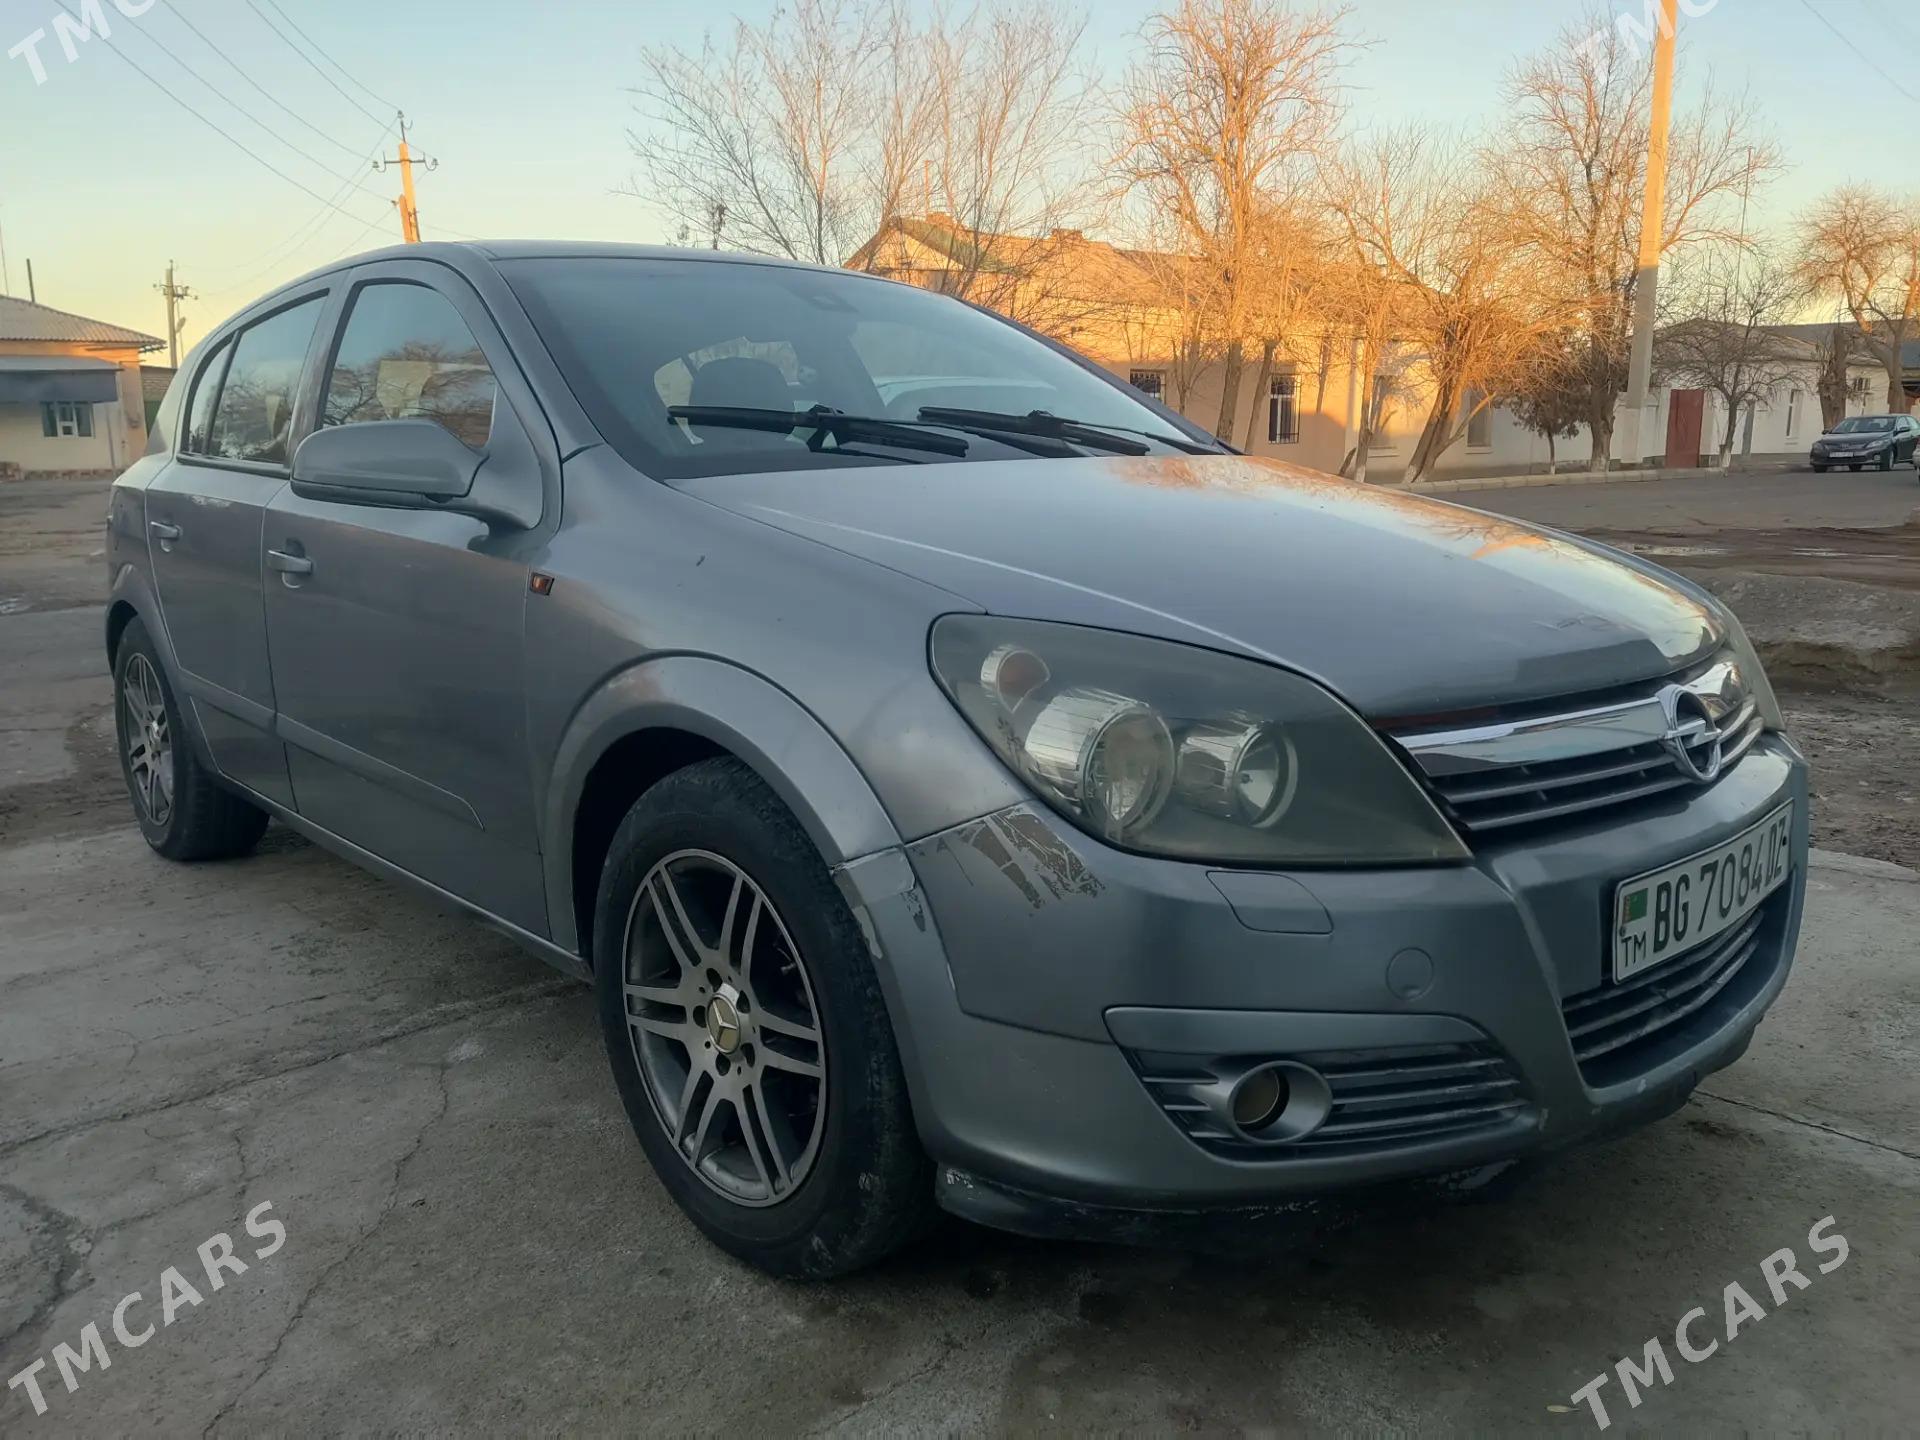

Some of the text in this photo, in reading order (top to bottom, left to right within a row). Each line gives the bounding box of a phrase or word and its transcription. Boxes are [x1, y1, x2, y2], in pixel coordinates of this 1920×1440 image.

[1653, 873, 1690, 953] BG
[1697, 832, 1764, 932] 7084
[1621, 931, 1646, 967] TM
